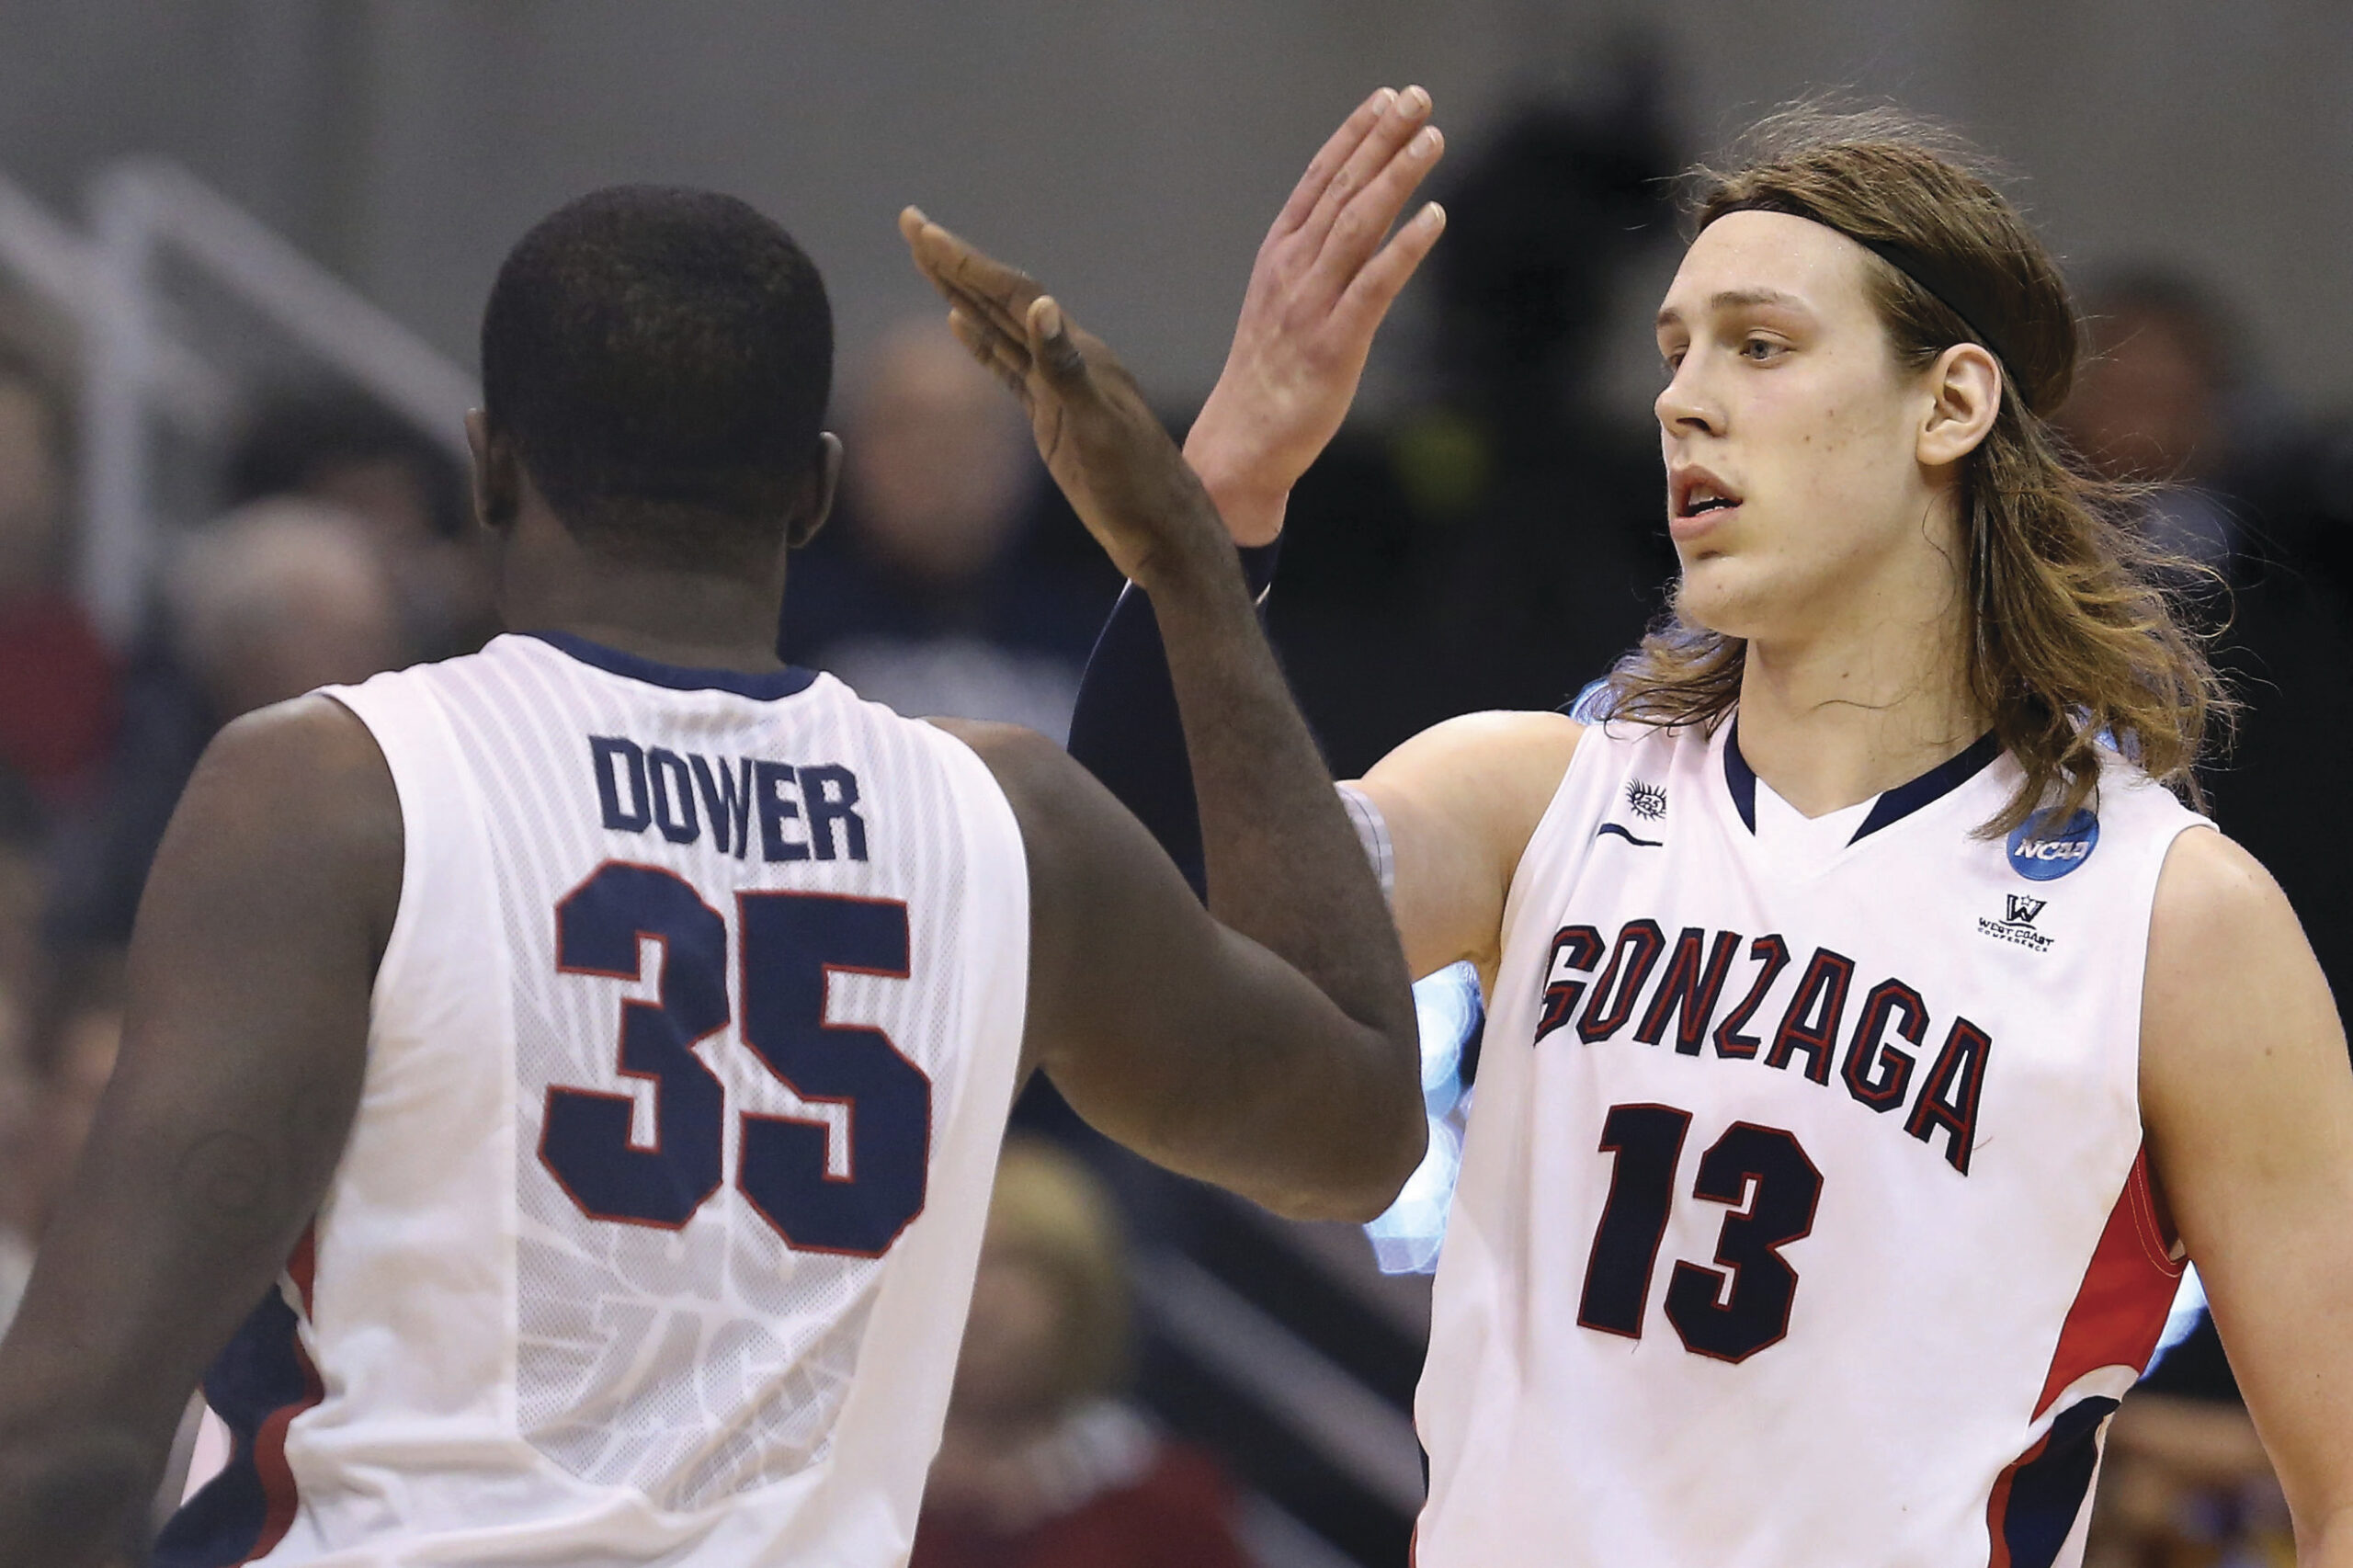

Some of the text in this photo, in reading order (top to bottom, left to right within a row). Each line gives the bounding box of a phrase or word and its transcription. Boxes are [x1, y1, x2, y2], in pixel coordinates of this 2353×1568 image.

[589, 735, 869, 862] DOWER
[2014, 838, 2089, 859] NCAA
[1979, 917, 2054, 946] WEST COAST
[538, 859, 932, 1258] 35
[1533, 919, 1993, 1176] GONZAGA
[1576, 1103, 1824, 1365] 13
